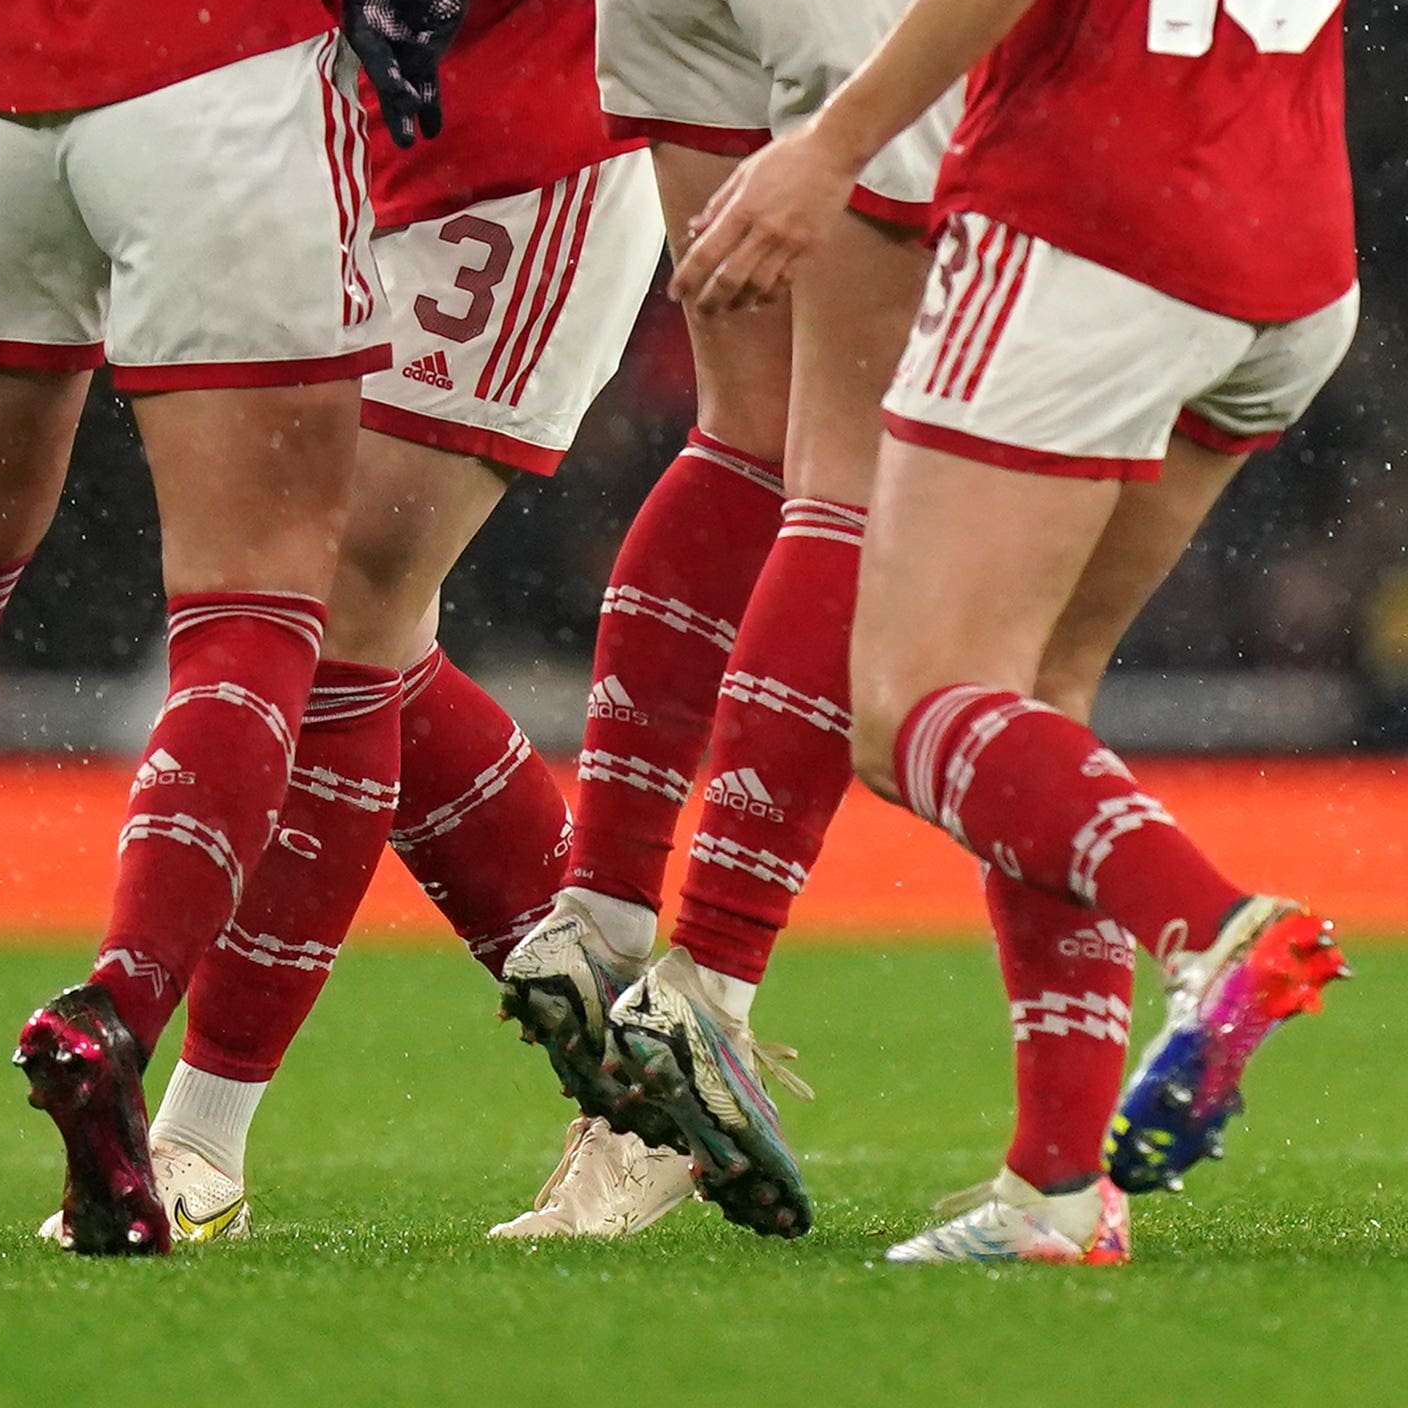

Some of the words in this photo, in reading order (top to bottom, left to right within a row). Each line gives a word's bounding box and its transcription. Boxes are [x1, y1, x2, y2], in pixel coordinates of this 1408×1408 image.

[413, 214, 514, 343] 3
[402, 365, 454, 391] adidas
[703, 784, 785, 824] adidas
